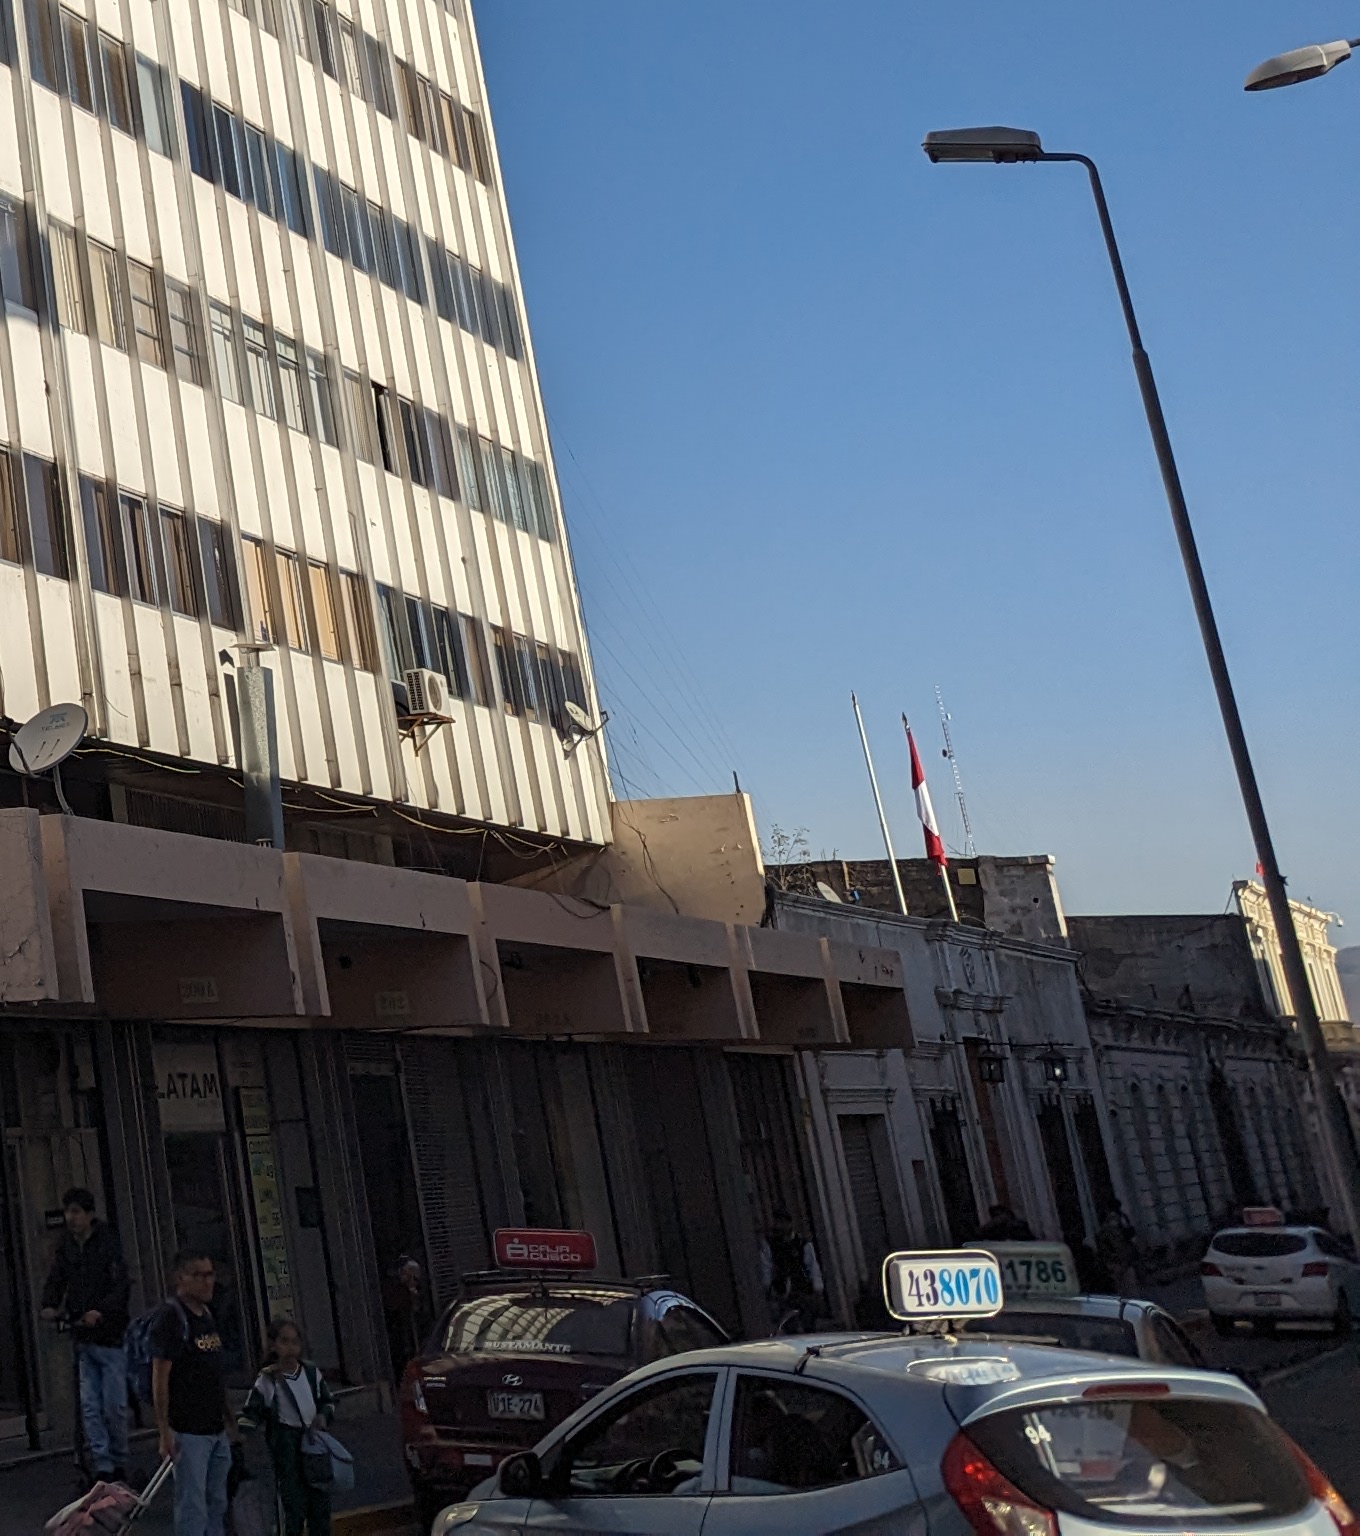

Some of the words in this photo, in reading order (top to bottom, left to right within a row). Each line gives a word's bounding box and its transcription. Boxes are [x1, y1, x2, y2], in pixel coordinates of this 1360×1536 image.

[530, 1252, 582, 1262] CUSCO
[908, 1267, 999, 1307] 438070
[1024, 1424, 1052, 1445] 94
